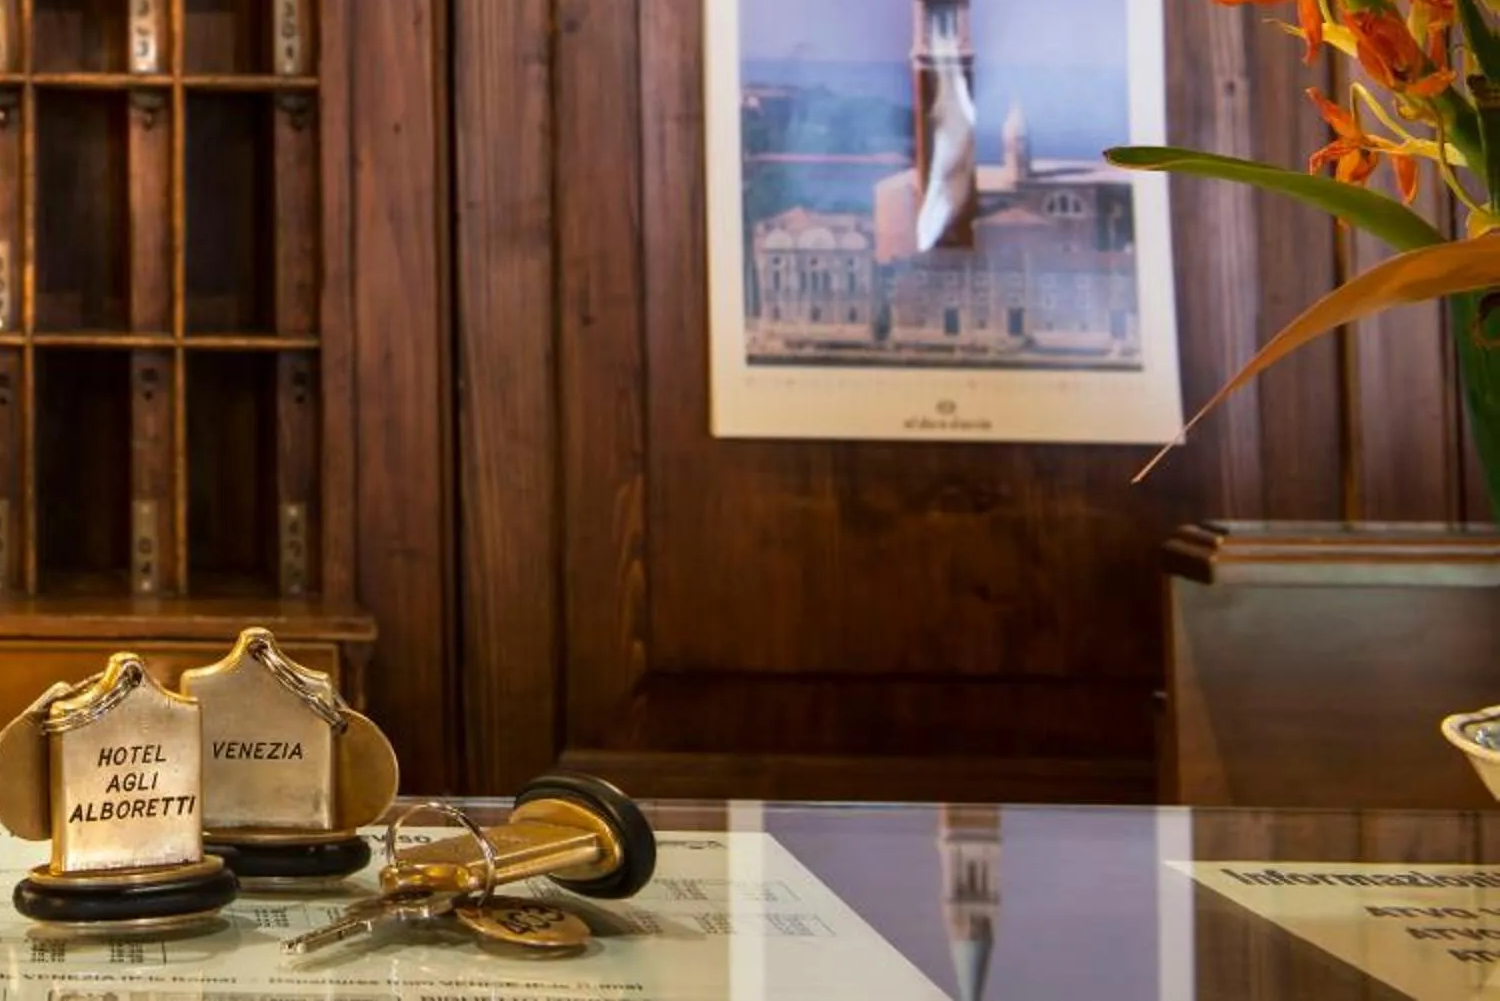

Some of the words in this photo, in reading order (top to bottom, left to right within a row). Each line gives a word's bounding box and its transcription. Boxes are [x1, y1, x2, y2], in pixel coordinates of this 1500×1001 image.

[98, 745, 167, 767] HOTEL
[213, 742, 303, 759] VENEZIA
[106, 772, 158, 793] AGLI
[69, 796, 195, 823] ALBORETTI
[1364, 905, 1479, 919] ATVO
